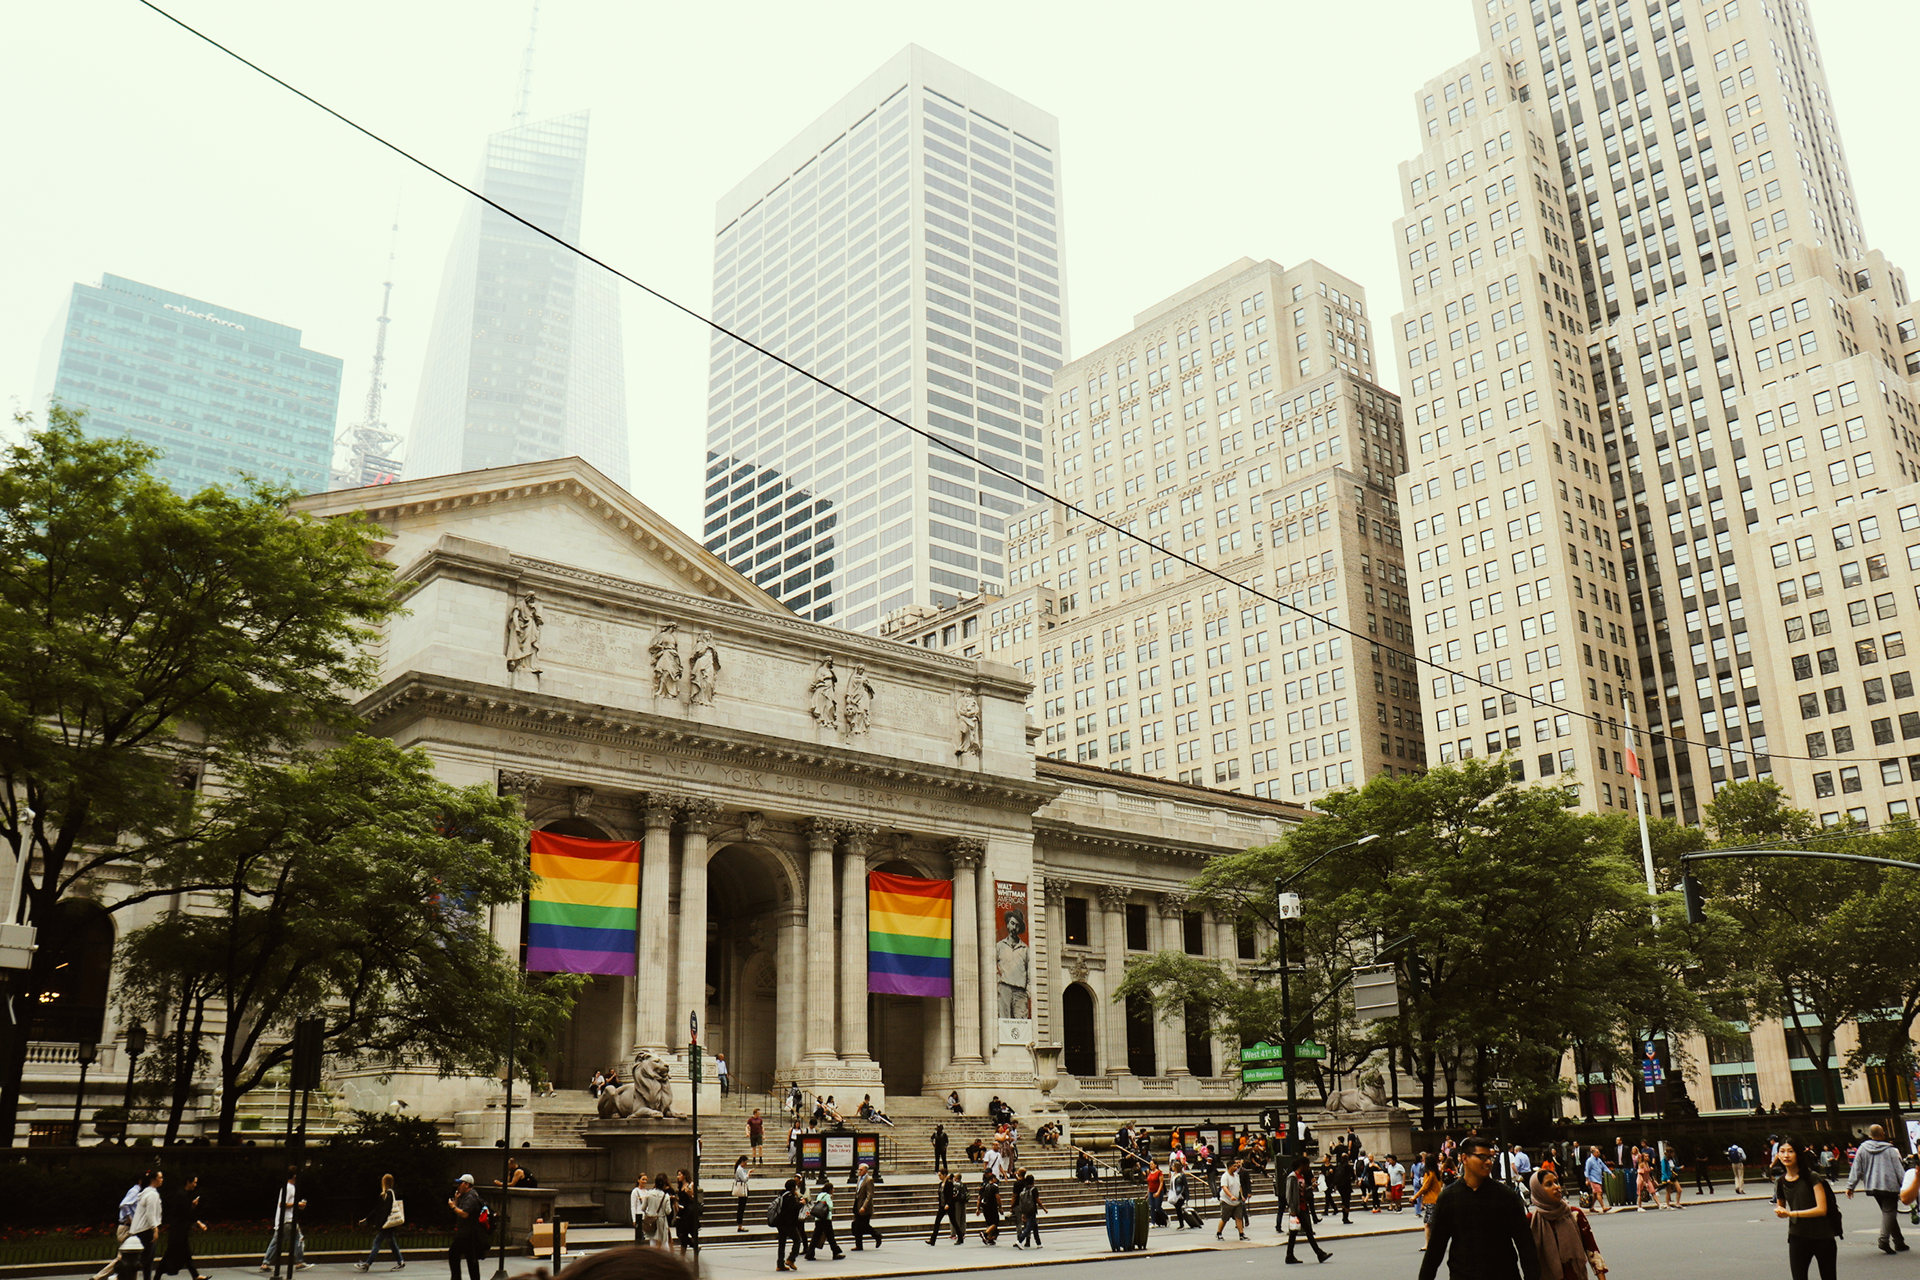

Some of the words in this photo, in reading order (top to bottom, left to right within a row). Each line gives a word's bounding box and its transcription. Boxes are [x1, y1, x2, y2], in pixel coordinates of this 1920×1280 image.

[548, 613, 567, 626] THE
[571, 620, 602, 633] ASTOR
[606, 624, 646, 641] LIBRARY
[741, 654, 768, 668] LENOX
[772, 660, 806, 675] LIBRARY
[508, 734, 578, 755] MDCCCXCV
[615, 750, 653, 770] THE
[665, 758, 707, 777] NEW
[722, 768, 764, 789] YORK
[776, 776, 831, 797] PUBLIC
[843, 787, 903, 808] LIBRARY
[997, 889, 1026, 898] WHITMAN
[997, 896, 1026, 904] AMERICA'S
[1244, 1050, 1260, 1059] West
[1261, 1050, 1271, 1058] 41st
[1273, 1048, 1280, 1057] St
[1299, 1047, 1310, 1056] Fifth
[1311, 1049, 1321, 1057] Ave
